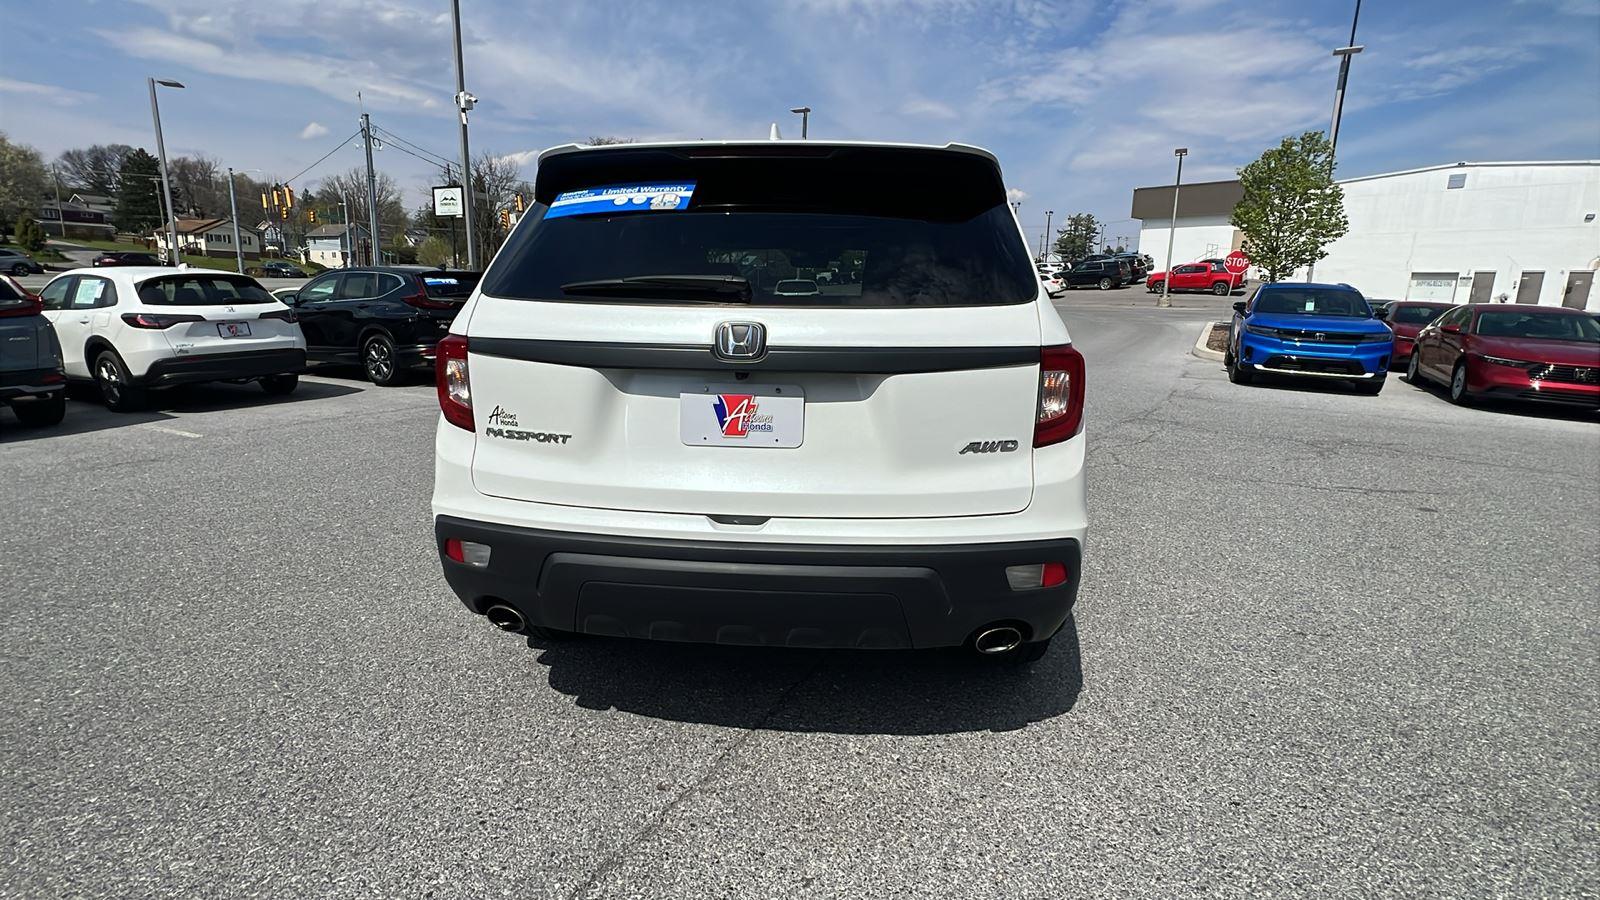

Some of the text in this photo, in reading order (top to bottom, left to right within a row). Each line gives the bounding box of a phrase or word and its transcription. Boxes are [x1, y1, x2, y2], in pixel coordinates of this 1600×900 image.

[602, 185, 688, 196] Limited Warranty
[1225, 257, 1250, 268] STOP
[500, 419, 519, 427] Honda
[742, 422, 773, 433] Honda
[485, 427, 573, 445] PASSPORT
[958, 439, 1020, 455] AWD
